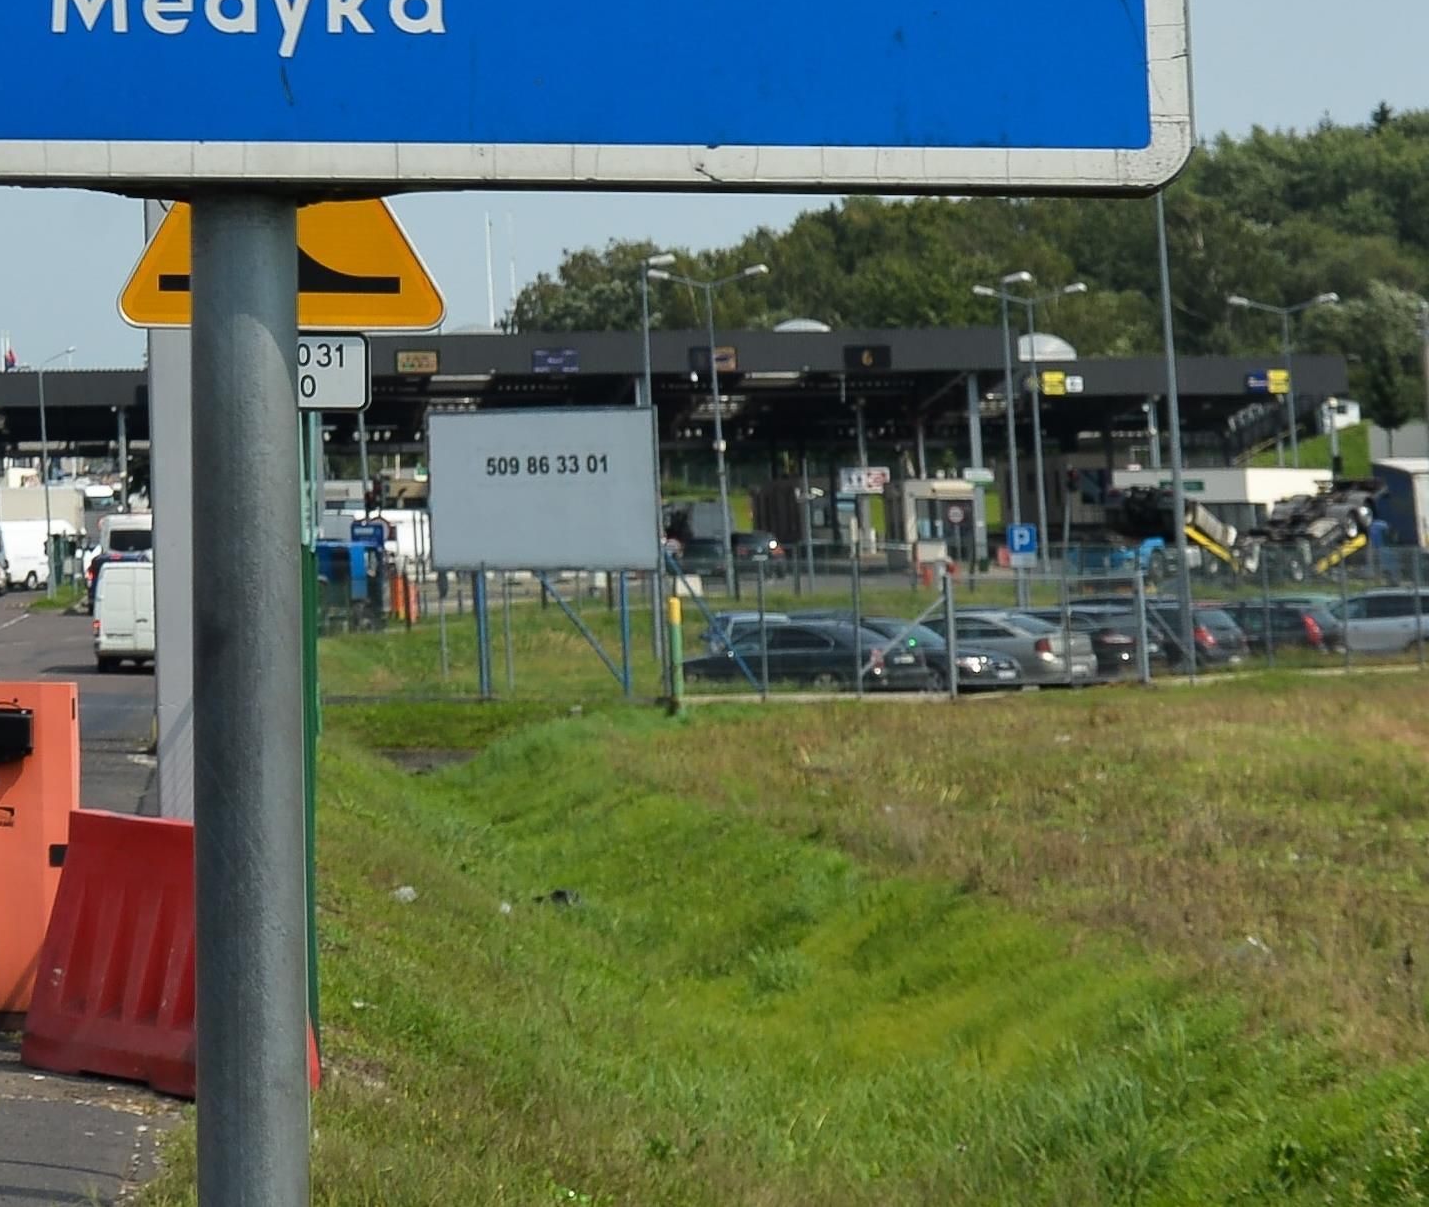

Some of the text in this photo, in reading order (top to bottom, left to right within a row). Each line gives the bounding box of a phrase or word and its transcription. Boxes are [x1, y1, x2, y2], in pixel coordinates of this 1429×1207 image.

[486, 454, 608, 476] 509 86 33 01
[1013, 528, 1030, 552] P
